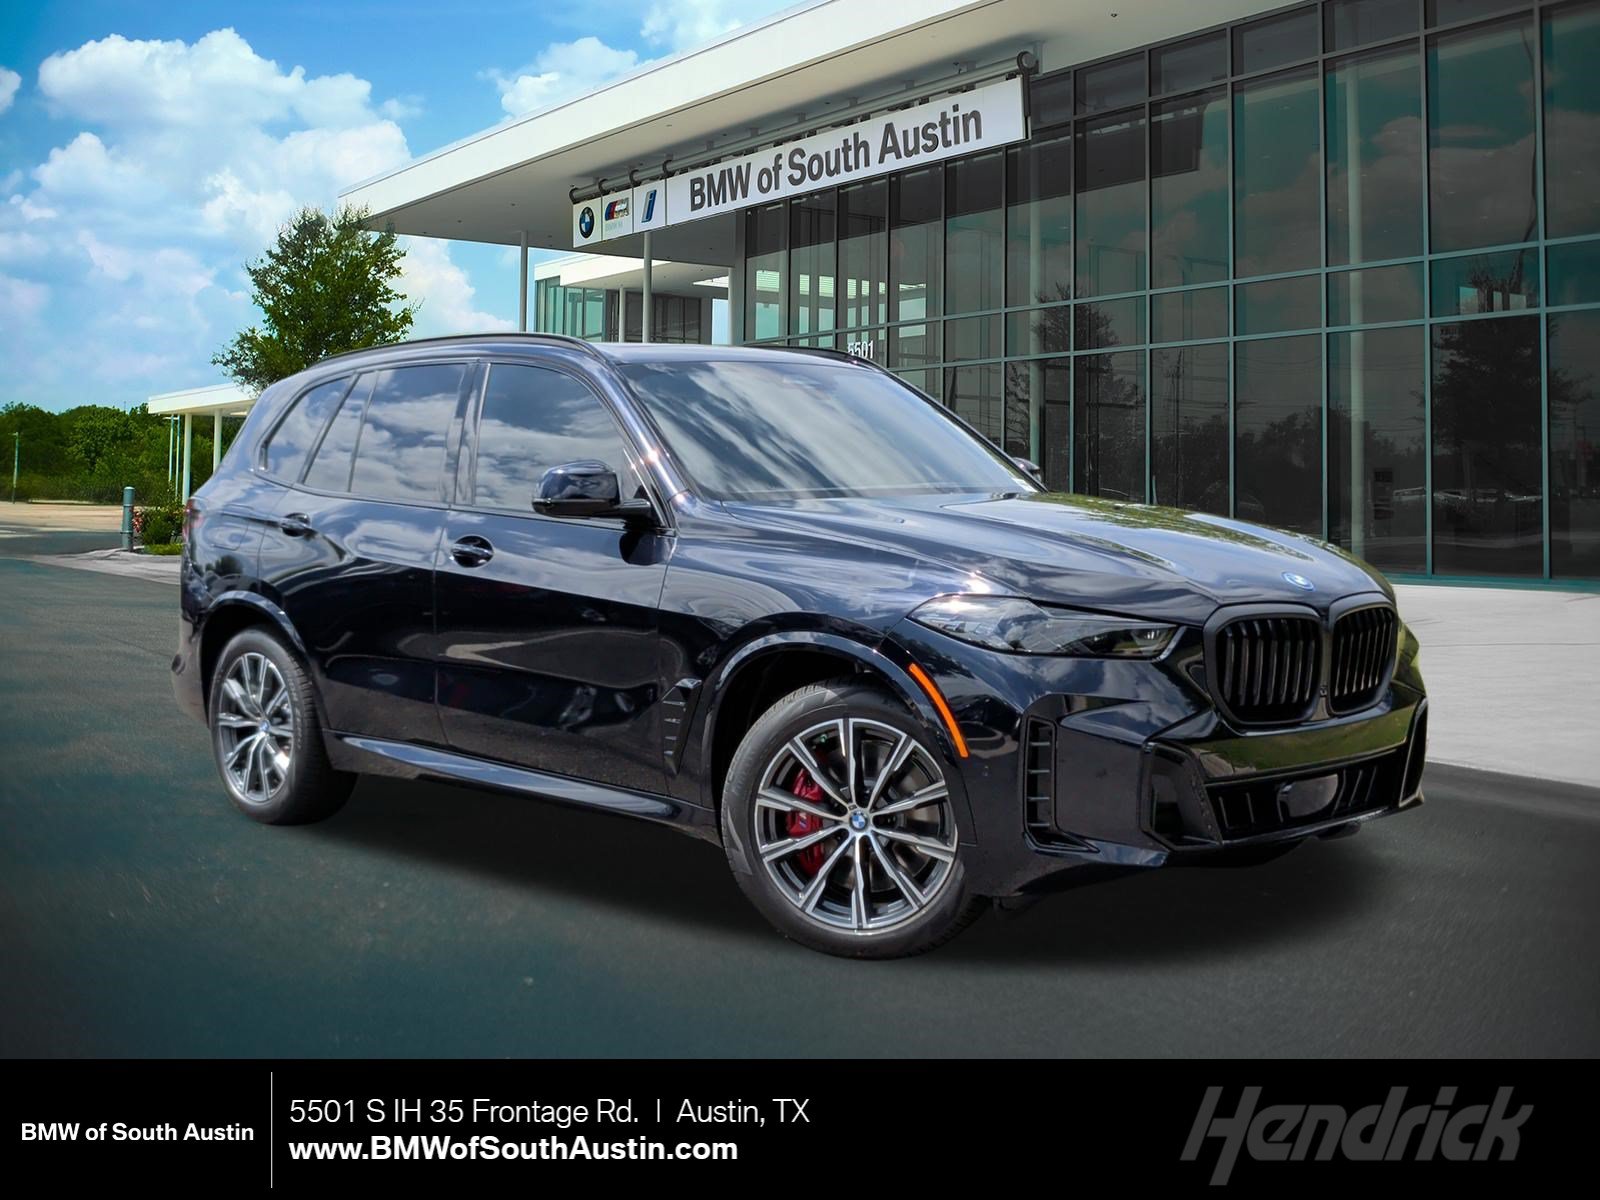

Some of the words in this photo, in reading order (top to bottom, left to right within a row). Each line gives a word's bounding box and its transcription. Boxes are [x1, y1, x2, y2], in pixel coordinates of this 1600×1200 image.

[690, 162, 752, 212] BMW
[757, 152, 783, 194] of
[787, 132, 870, 187] South
[878, 103, 983, 164] Austin
[847, 340, 873, 359] 5501
